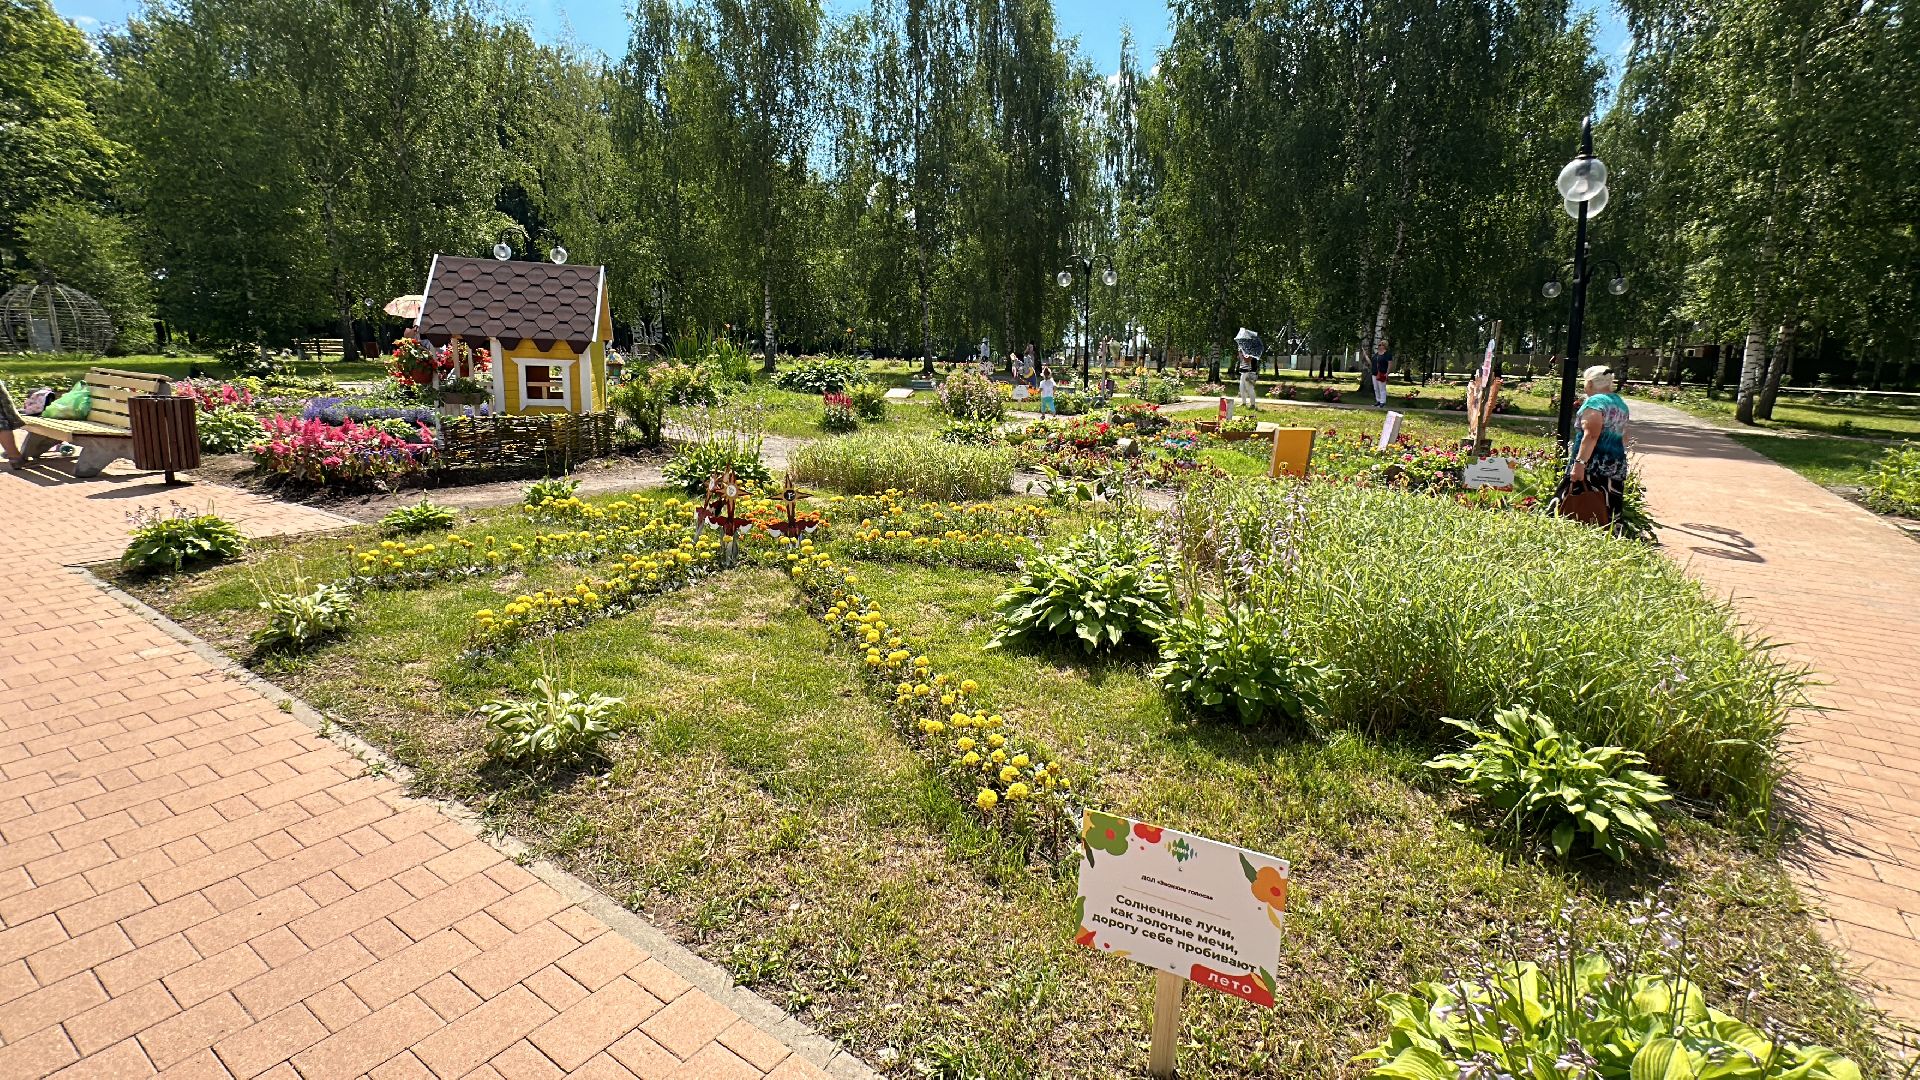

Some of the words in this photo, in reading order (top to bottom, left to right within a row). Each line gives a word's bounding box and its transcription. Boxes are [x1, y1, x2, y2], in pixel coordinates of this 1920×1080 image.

[1110, 905, 1134, 920] как
[1136, 913, 1195, 938] золотые
[1197, 932, 1239, 955] мечи,
[1115, 893, 1193, 926] Солнечные
[1196, 920, 1235, 941] лучи,
[1092, 912, 1139, 935] дорогу
[1142, 926, 1174, 946] себе
[1177, 940, 1257, 973] пробивают
[1208, 972, 1253, 995] лето
